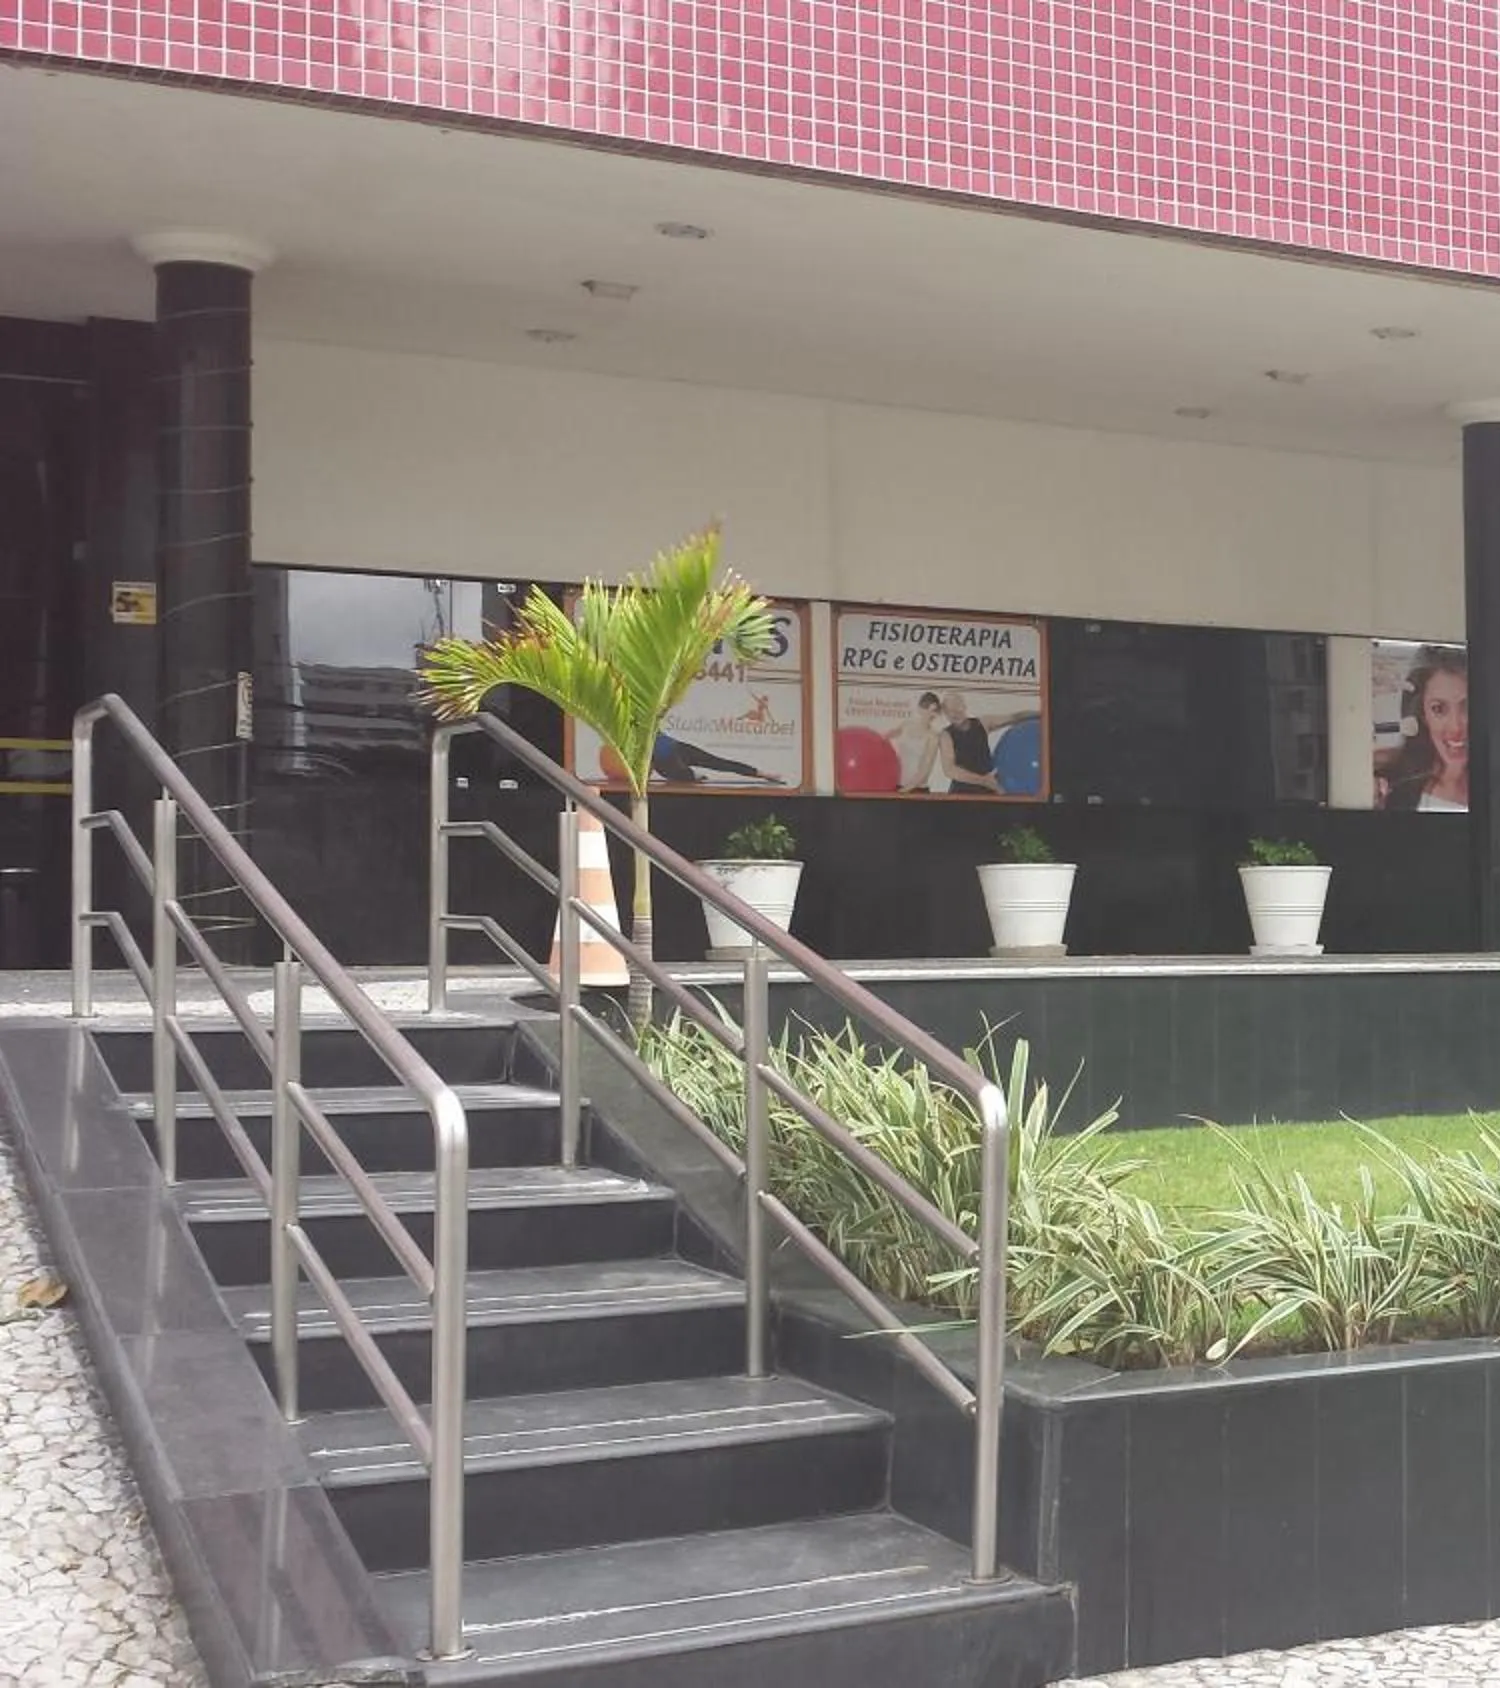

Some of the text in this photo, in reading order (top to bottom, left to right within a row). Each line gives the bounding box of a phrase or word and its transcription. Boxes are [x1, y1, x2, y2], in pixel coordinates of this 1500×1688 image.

[868, 621, 1012, 649] FISIOTERAPIA
[843, 647, 1036, 677] RPG e OSTEOPATIA
